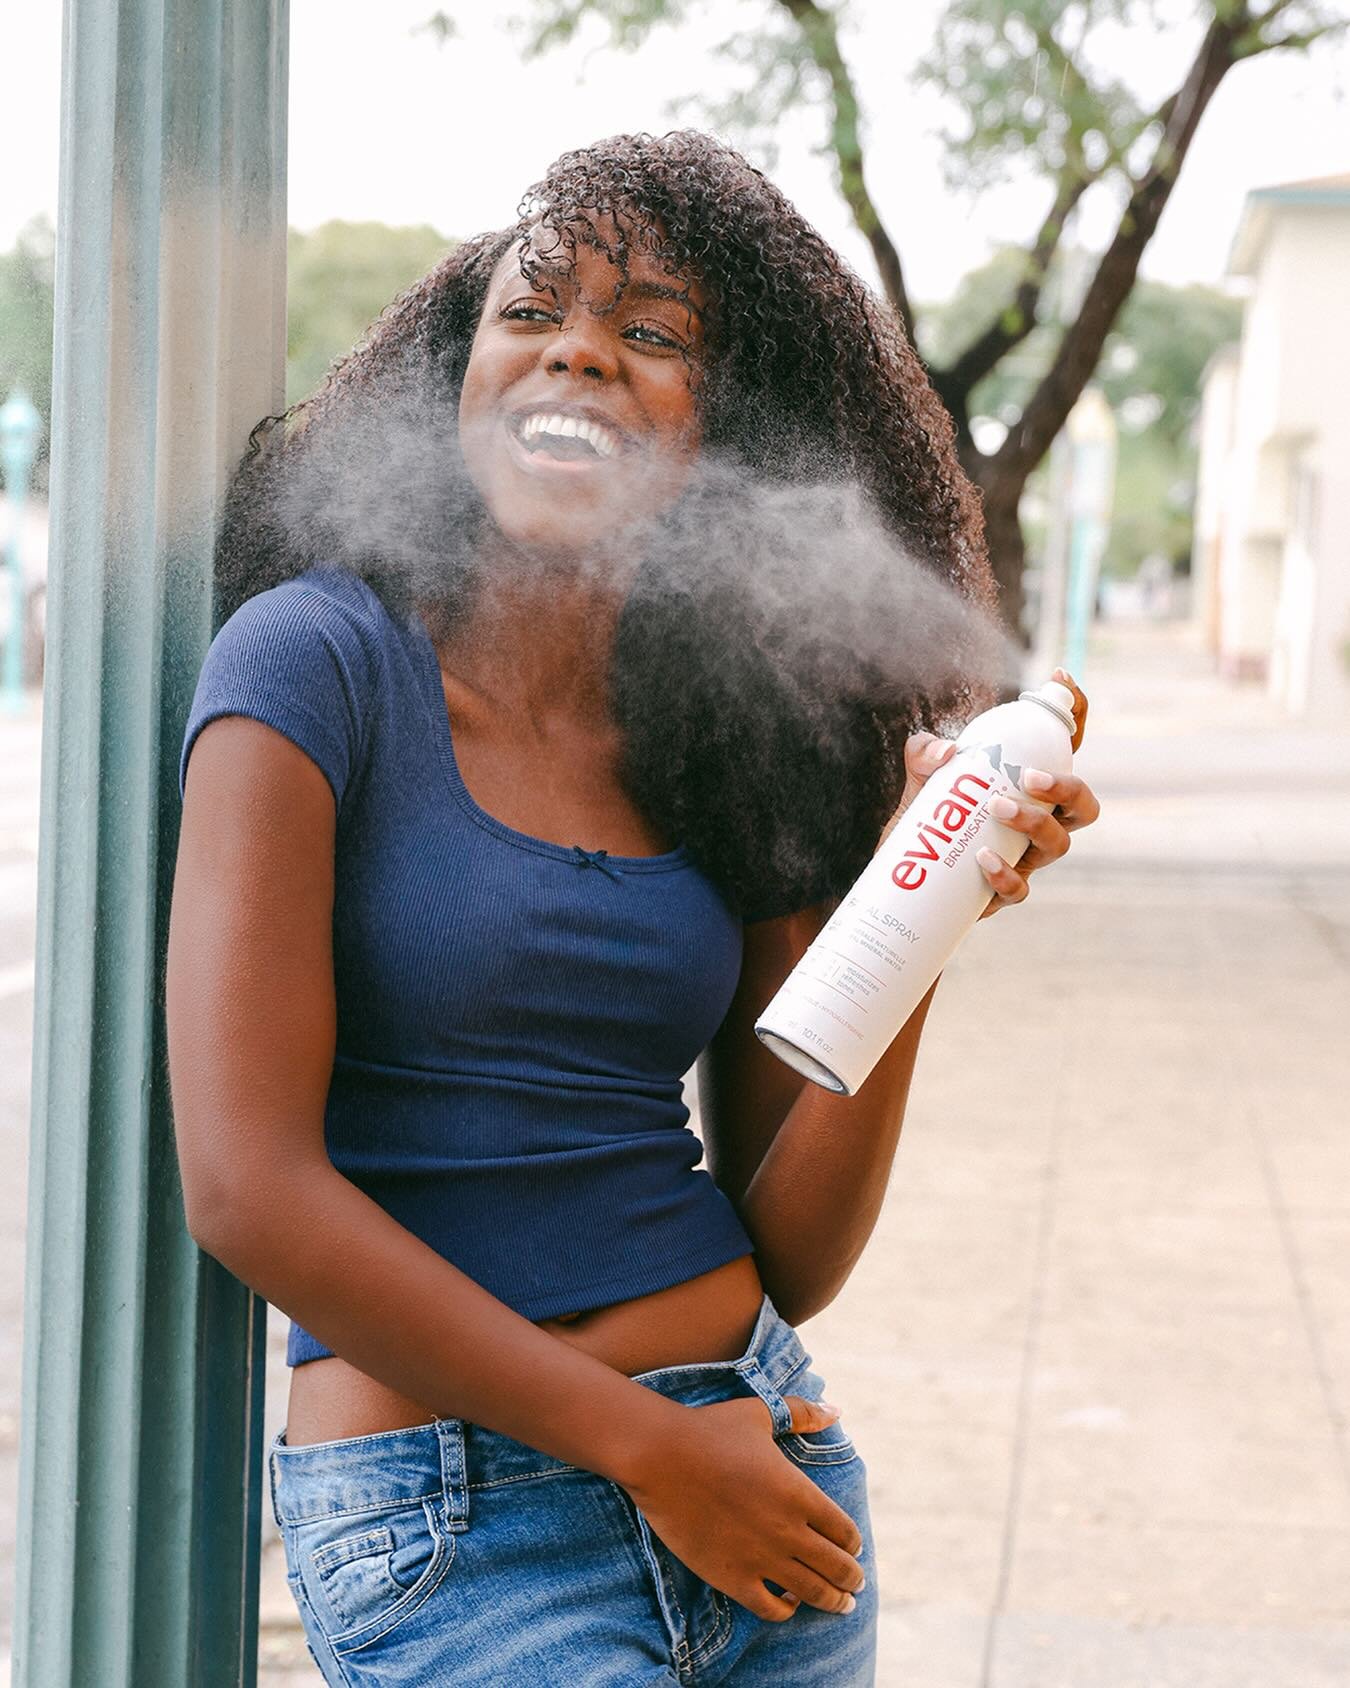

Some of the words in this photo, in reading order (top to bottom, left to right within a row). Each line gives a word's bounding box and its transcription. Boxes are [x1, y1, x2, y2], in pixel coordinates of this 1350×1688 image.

[892, 774, 990, 890] evian
[943, 789, 1004, 868] BRUMISATE
[880, 914, 920, 944] SPRAY
